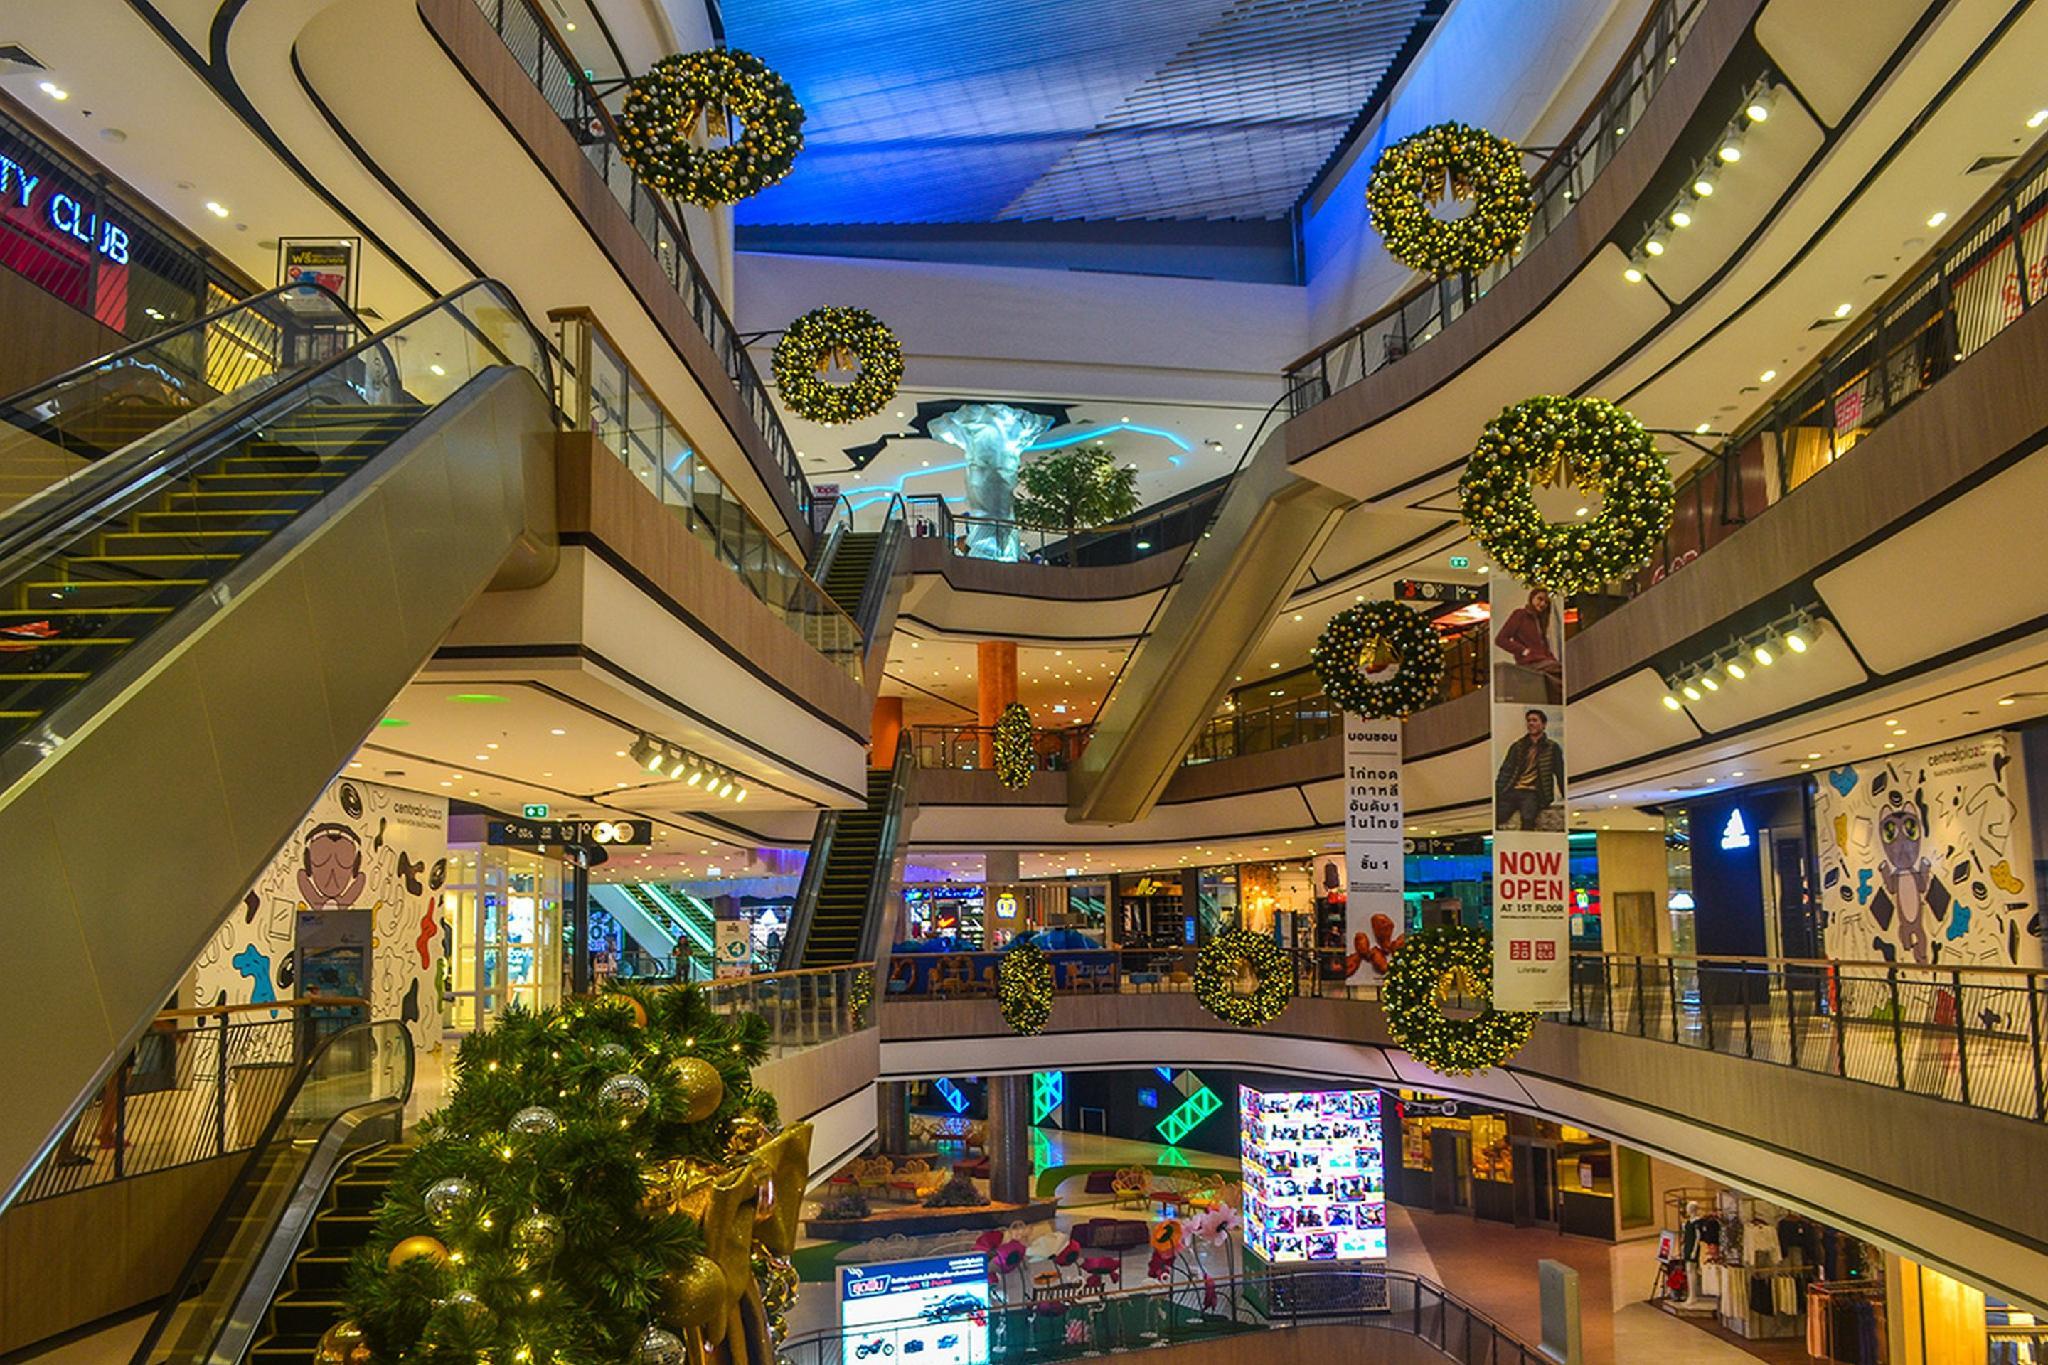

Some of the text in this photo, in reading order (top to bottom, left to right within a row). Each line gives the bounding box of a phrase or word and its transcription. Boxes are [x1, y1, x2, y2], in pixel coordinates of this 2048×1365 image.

[49, 192, 130, 265] CLUB
[1349, 766, 1398, 780] ไก่ทอด
[1350, 783, 1399, 796] เกาหลี
[1361, 854, 1389, 870] ชั้น 1
[1500, 851, 1562, 876] NOW
[1500, 879, 1563, 901] OPEN
[1500, 904, 1564, 914] AT 1ST FLOOR
